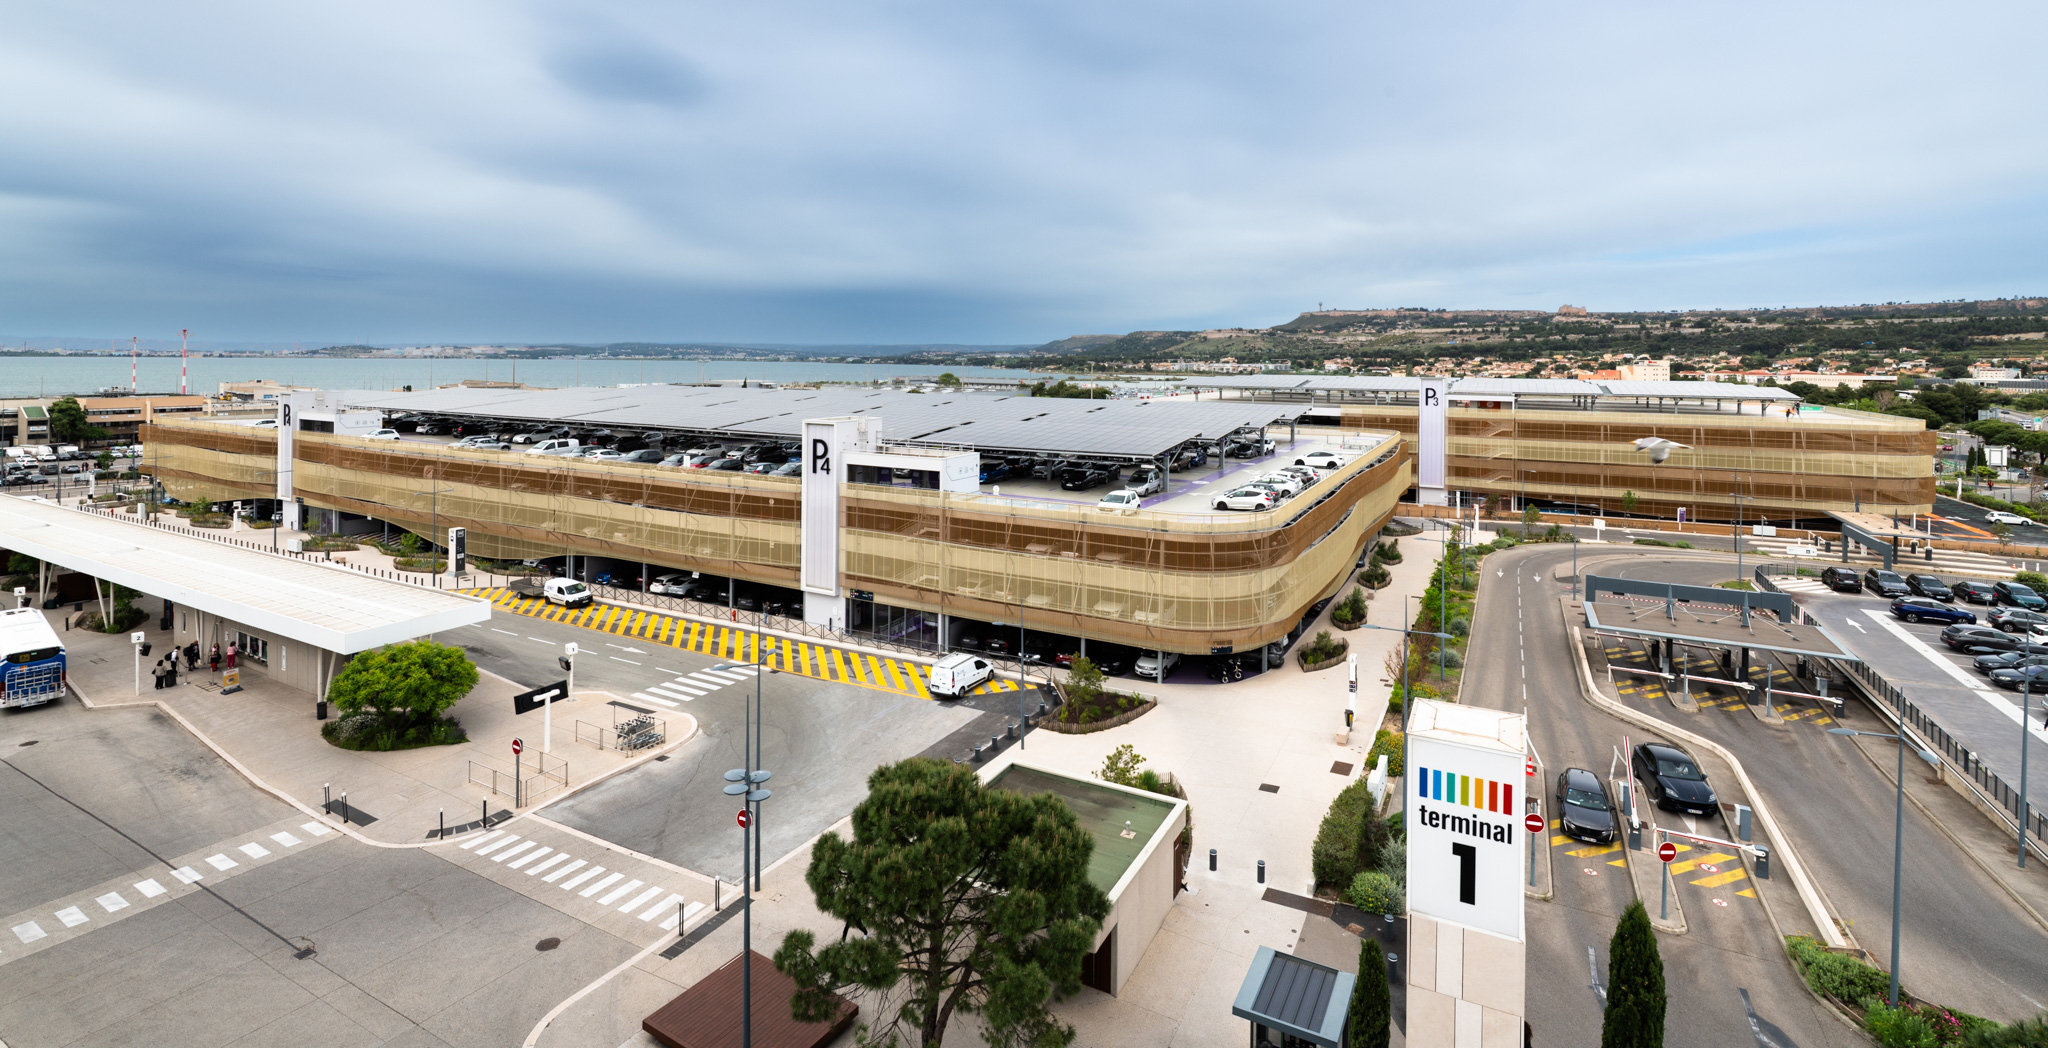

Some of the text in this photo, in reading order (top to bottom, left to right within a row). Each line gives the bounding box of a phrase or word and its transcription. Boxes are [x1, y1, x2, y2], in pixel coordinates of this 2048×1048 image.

[1425, 387, 1439, 407] P3
[812, 438, 831, 475] P4
[1418, 804, 1513, 845] terminal
[1452, 842, 1476, 906] 1
